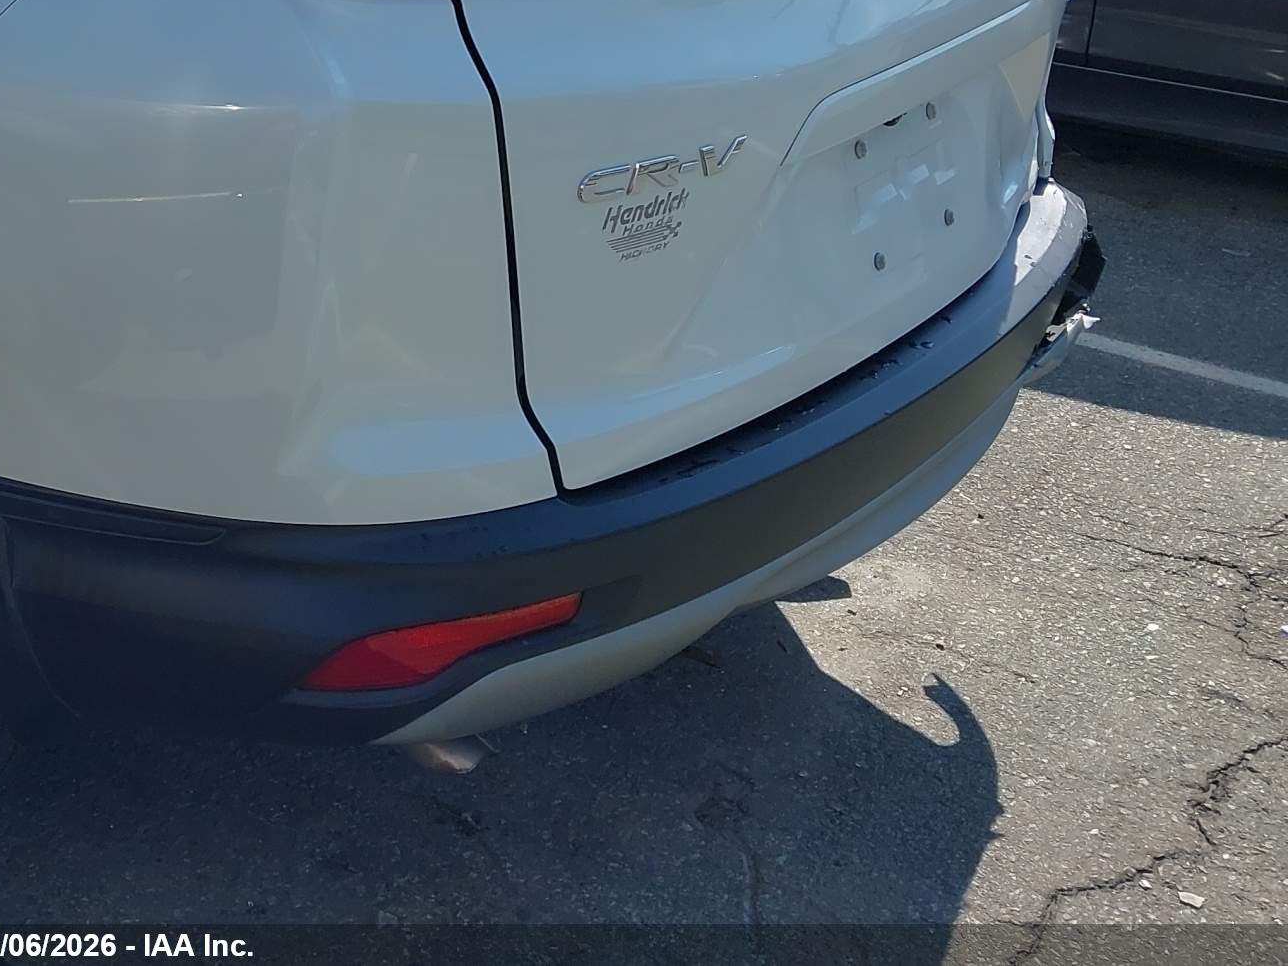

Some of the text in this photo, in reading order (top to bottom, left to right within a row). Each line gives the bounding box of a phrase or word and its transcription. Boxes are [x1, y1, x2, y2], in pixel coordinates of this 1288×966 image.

[577, 134, 748, 202] CR-V
[602, 188, 690, 234] Hendrick
[622, 216, 673, 236] Honda
